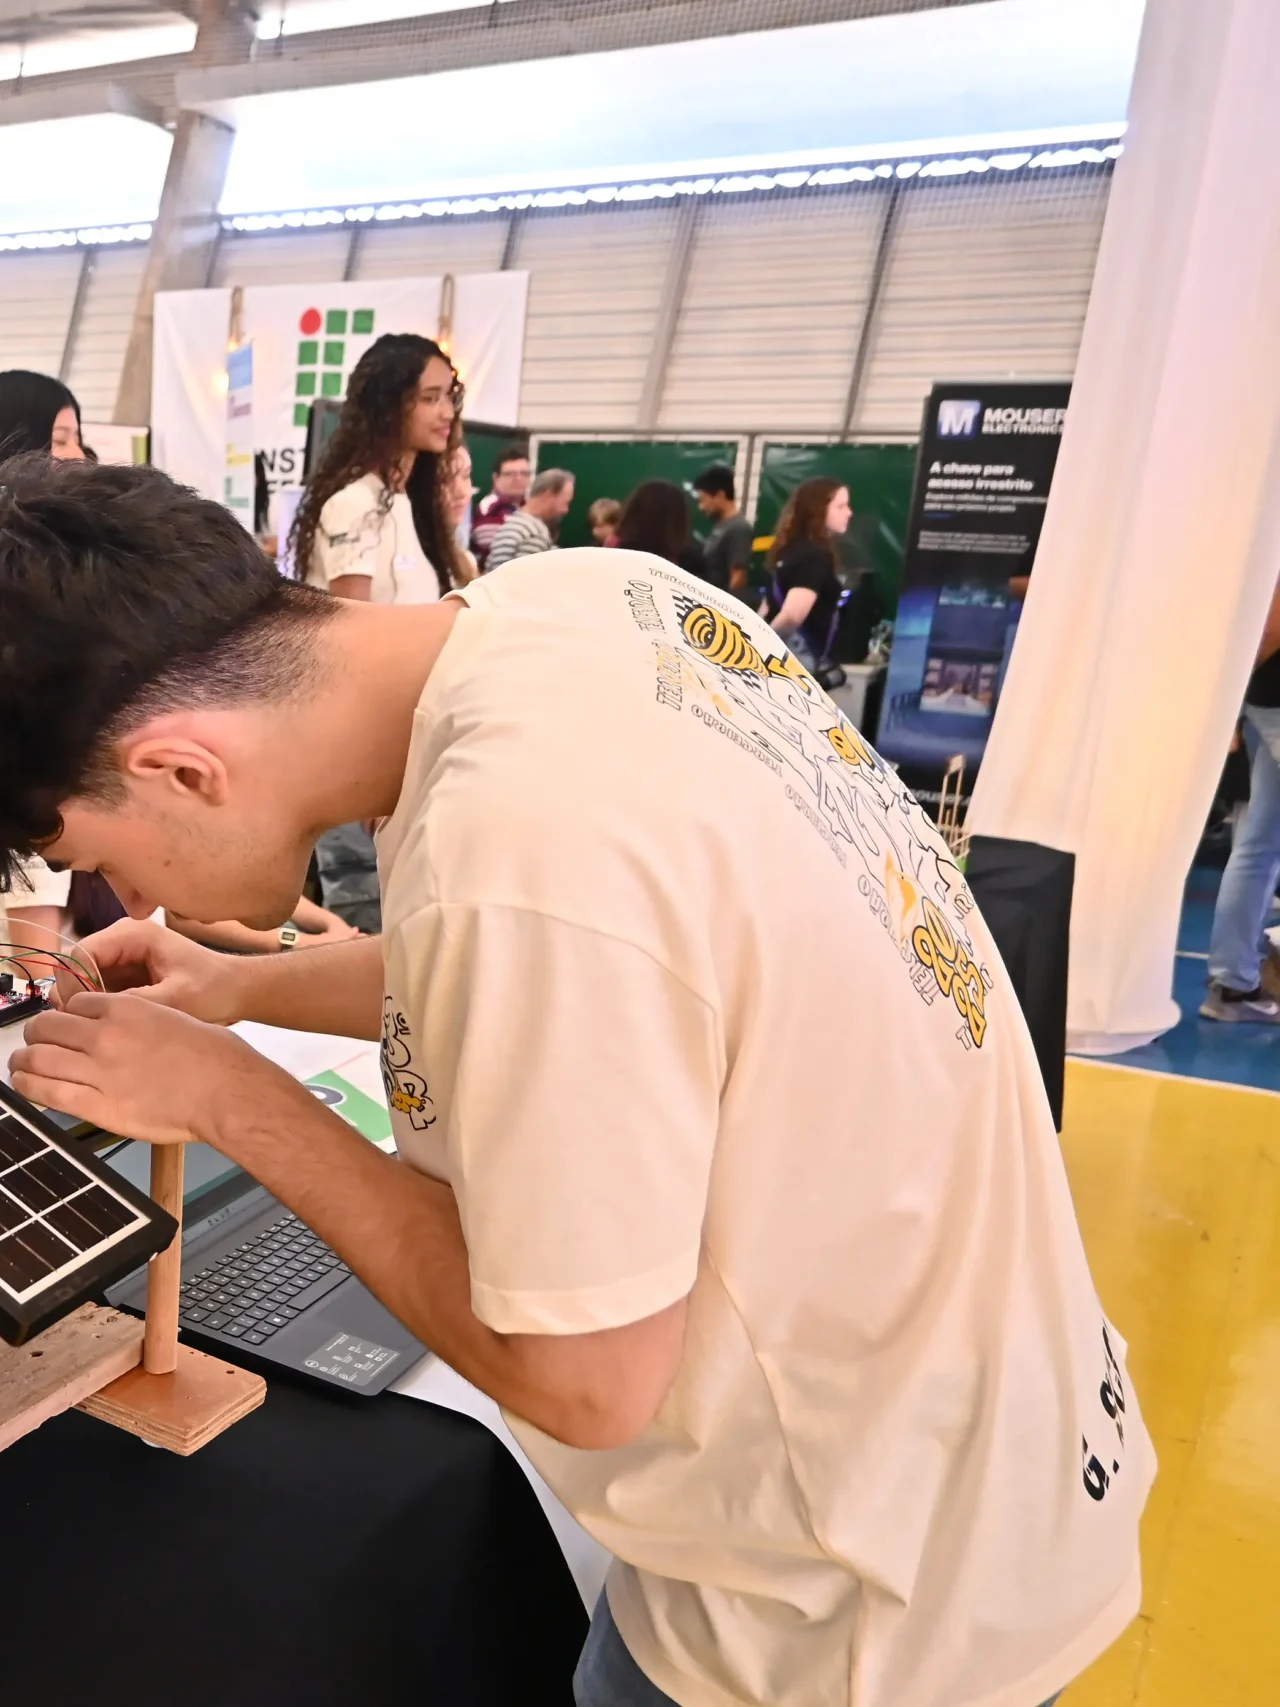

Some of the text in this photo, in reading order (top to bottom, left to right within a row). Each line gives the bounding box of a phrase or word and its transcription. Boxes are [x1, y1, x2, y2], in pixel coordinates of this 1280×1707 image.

[929, 461, 1015, 477] A chave para
[927, 478, 974, 490] acesso
